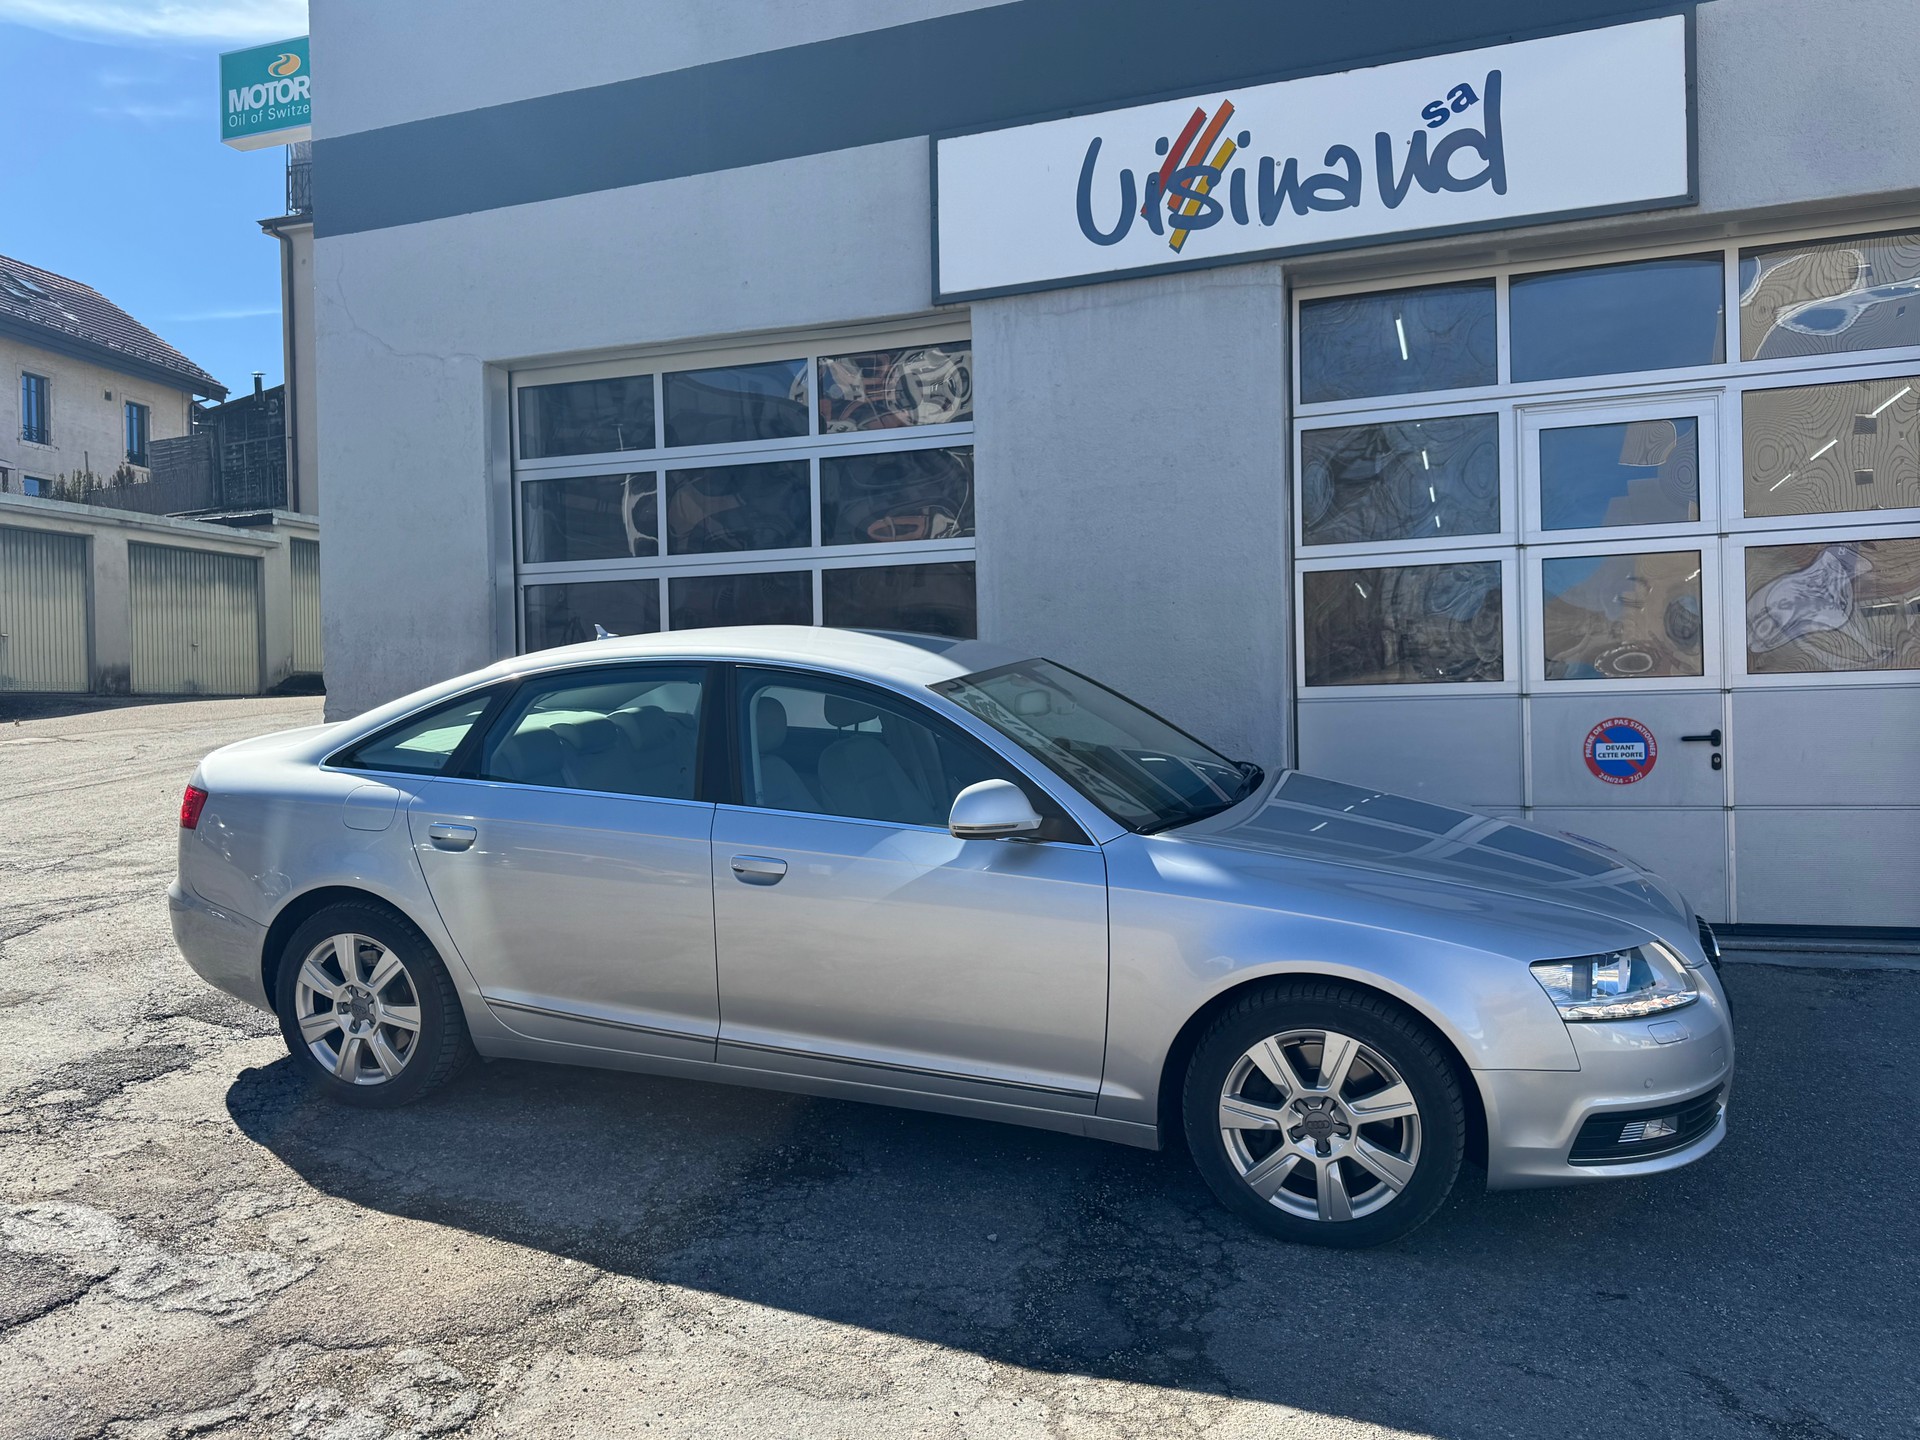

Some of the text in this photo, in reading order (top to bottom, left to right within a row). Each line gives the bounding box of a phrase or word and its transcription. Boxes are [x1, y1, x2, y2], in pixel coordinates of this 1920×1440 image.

[228, 104, 310, 127] Oil of Switze
[1420, 82, 1479, 129] sa
[1593, 726, 1603, 735] DE
[1603, 720, 1613, 729] NE
[1629, 721, 1656, 757] STATIONNER
